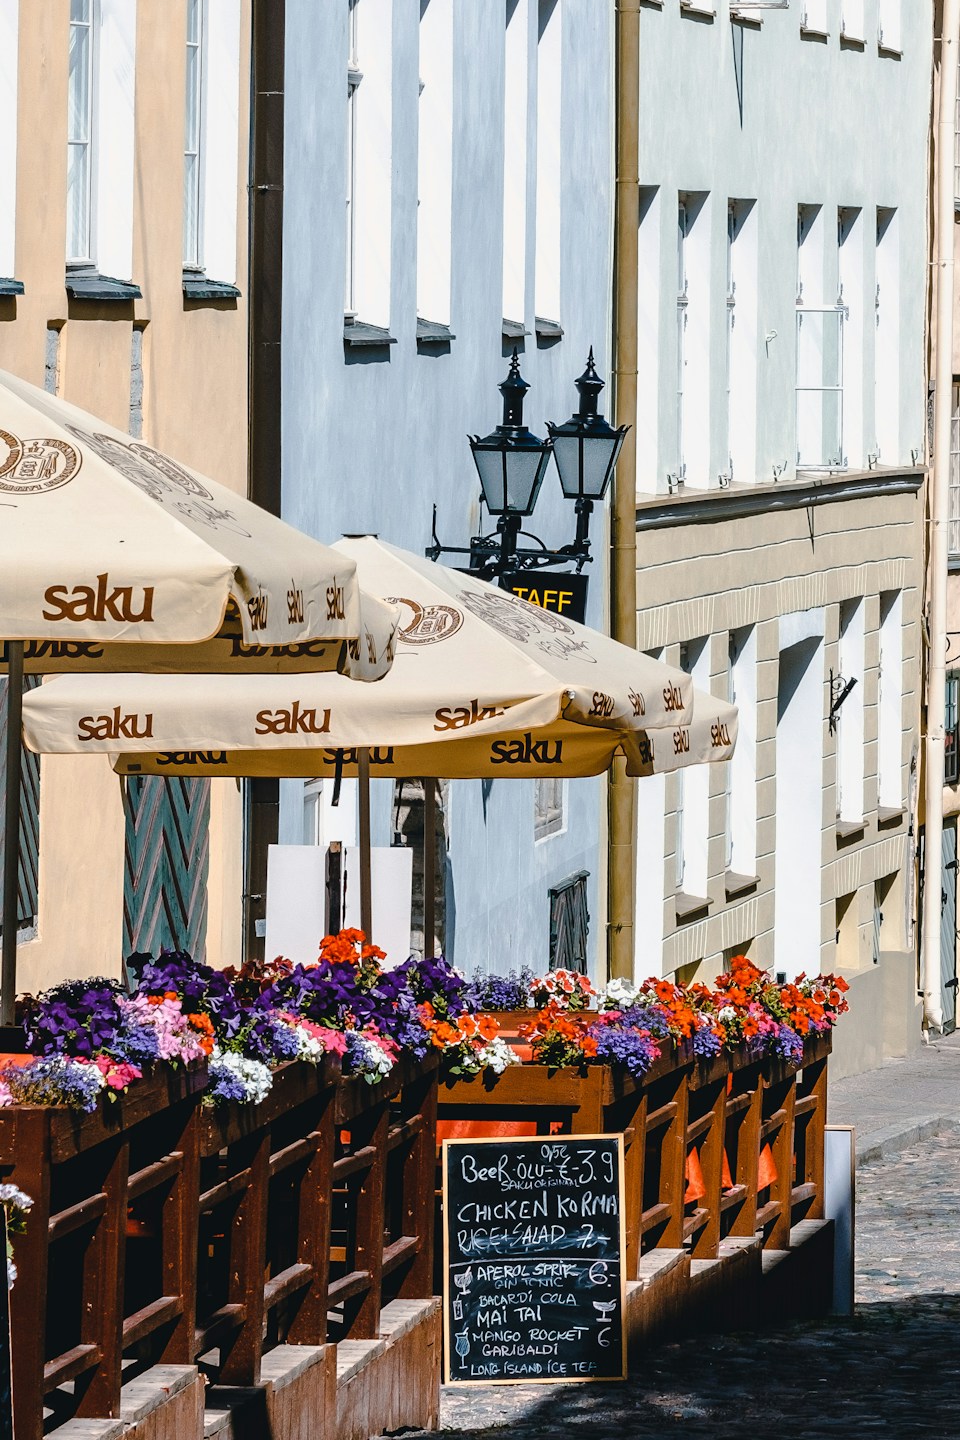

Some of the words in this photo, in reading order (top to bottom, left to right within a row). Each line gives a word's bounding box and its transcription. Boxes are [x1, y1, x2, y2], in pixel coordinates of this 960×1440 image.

[42, 572, 155, 623] saku
[326, 575, 346, 621] saku
[588, 691, 615, 717] saku
[662, 679, 685, 712] saku
[77, 705, 153, 741] saku
[254, 700, 331, 735] saku
[673, 726, 690, 755] saku
[710, 716, 732, 747] saku
[490, 732, 563, 764] saku
[457, 1190, 548, 1223] CHICKEN
[557, 1190, 618, 1219] KORMA
[477, 1263, 530, 1281] APEROL
[514, 1305, 542, 1322] TAI
[540, 1292, 577, 1306] COLA
[472, 1329, 521, 1342] MANGO
[528, 1326, 589, 1341] ROCKET
[470, 1363, 500, 1376] LONG
